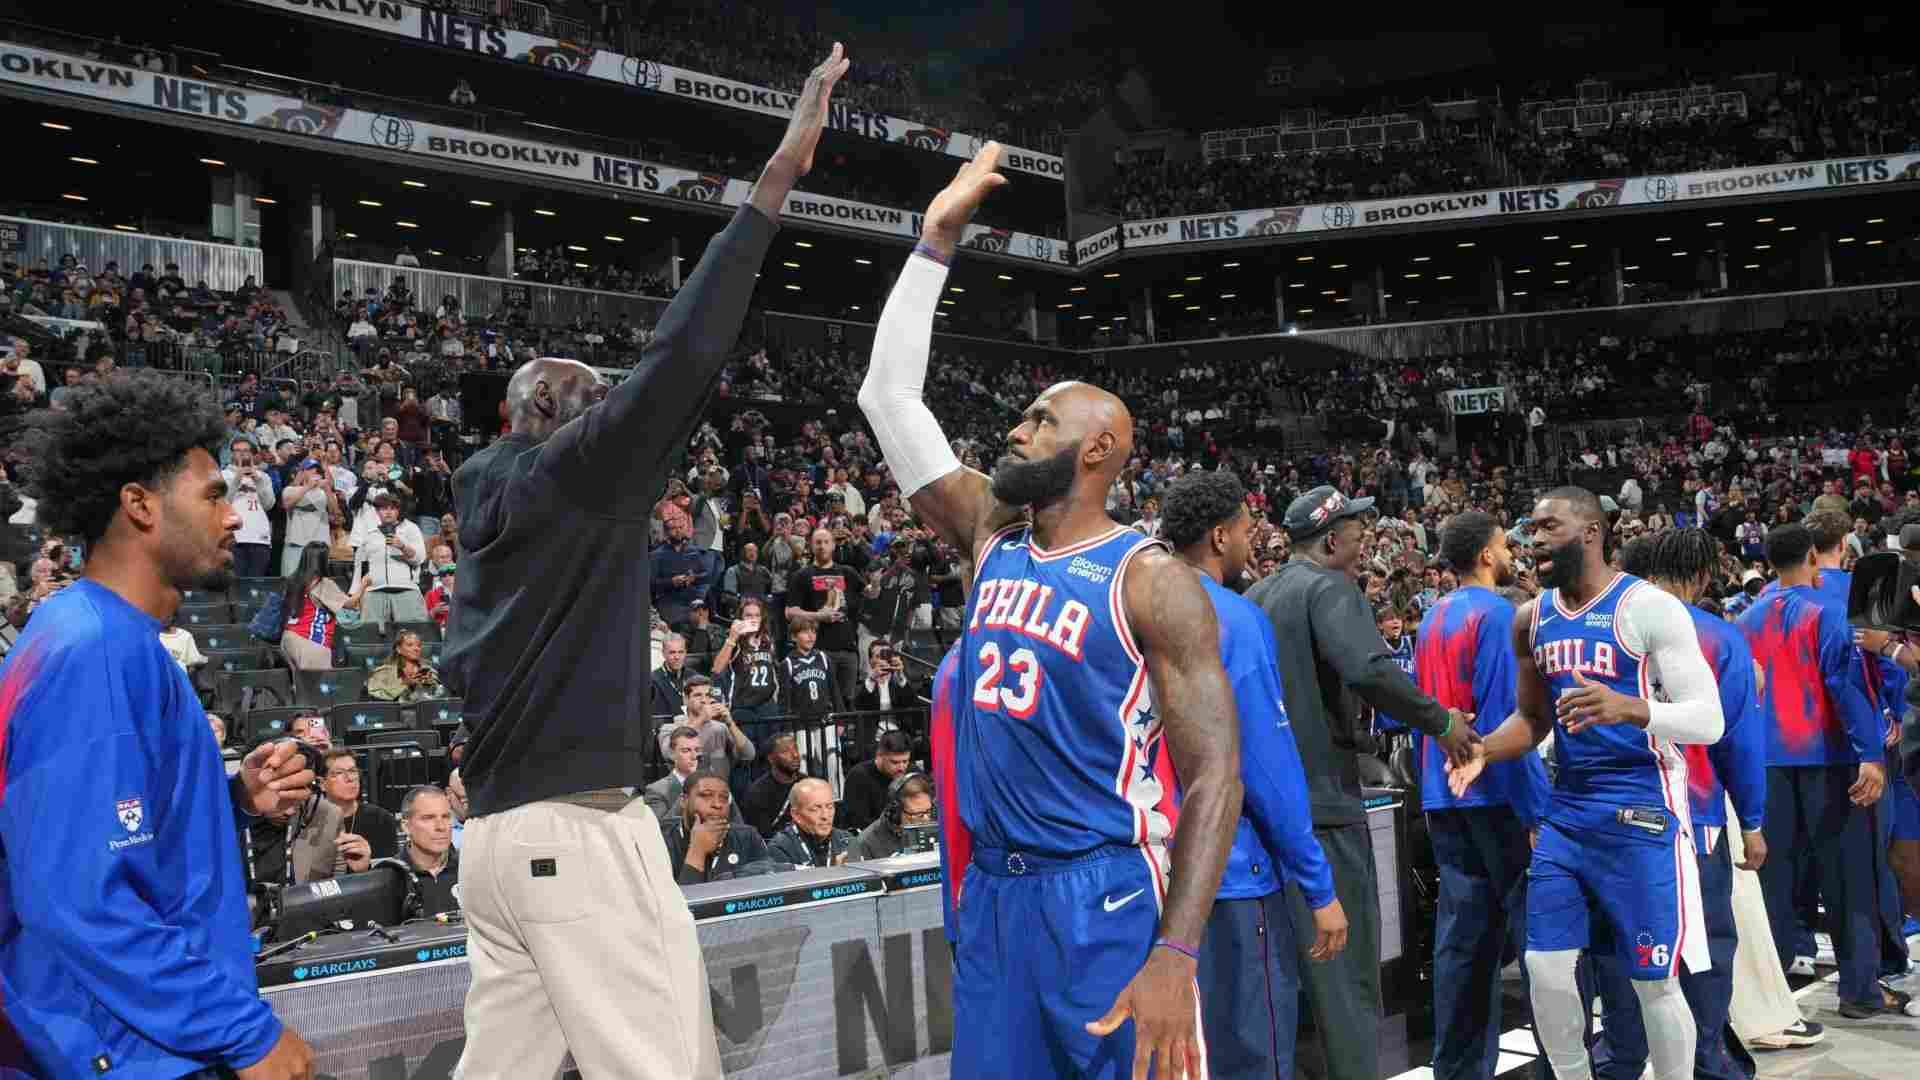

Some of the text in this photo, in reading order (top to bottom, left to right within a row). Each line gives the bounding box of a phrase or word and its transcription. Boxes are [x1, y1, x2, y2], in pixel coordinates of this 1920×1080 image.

[421, 10, 507, 58] NETS
[1, 53, 248, 120] OKLYN NETS
[674, 77, 799, 110] BROOKLY
[830, 102, 889, 142] NETS
[428, 136, 580, 167] BROOKLYN
[593, 156, 660, 191] NETS
[1008, 156, 1064, 176] BROO
[1688, 166, 1814, 195] BROOKLYN
[1826, 160, 1889, 185] NETS
[788, 200, 904, 224] BROOKLYN
[1365, 193, 1489, 223] BROOKLYN
[1500, 189, 1560, 212] NETS
[1180, 215, 1239, 241] NETS
[1067, 566, 1107, 583] energy
[1072, 556, 1112, 576] Bloom
[969, 577, 1092, 662] PHILA
[1534, 638, 1618, 679] PHILA
[750, 665, 769, 687] 22
[809, 681, 819, 700] 8
[973, 641, 1042, 720] 23
[911, 871, 943, 884] BARCLA
[736, 882, 866, 911] BARCLAYS BARCLAYS
[311, 945, 466, 977] BARCLAYS BARC
